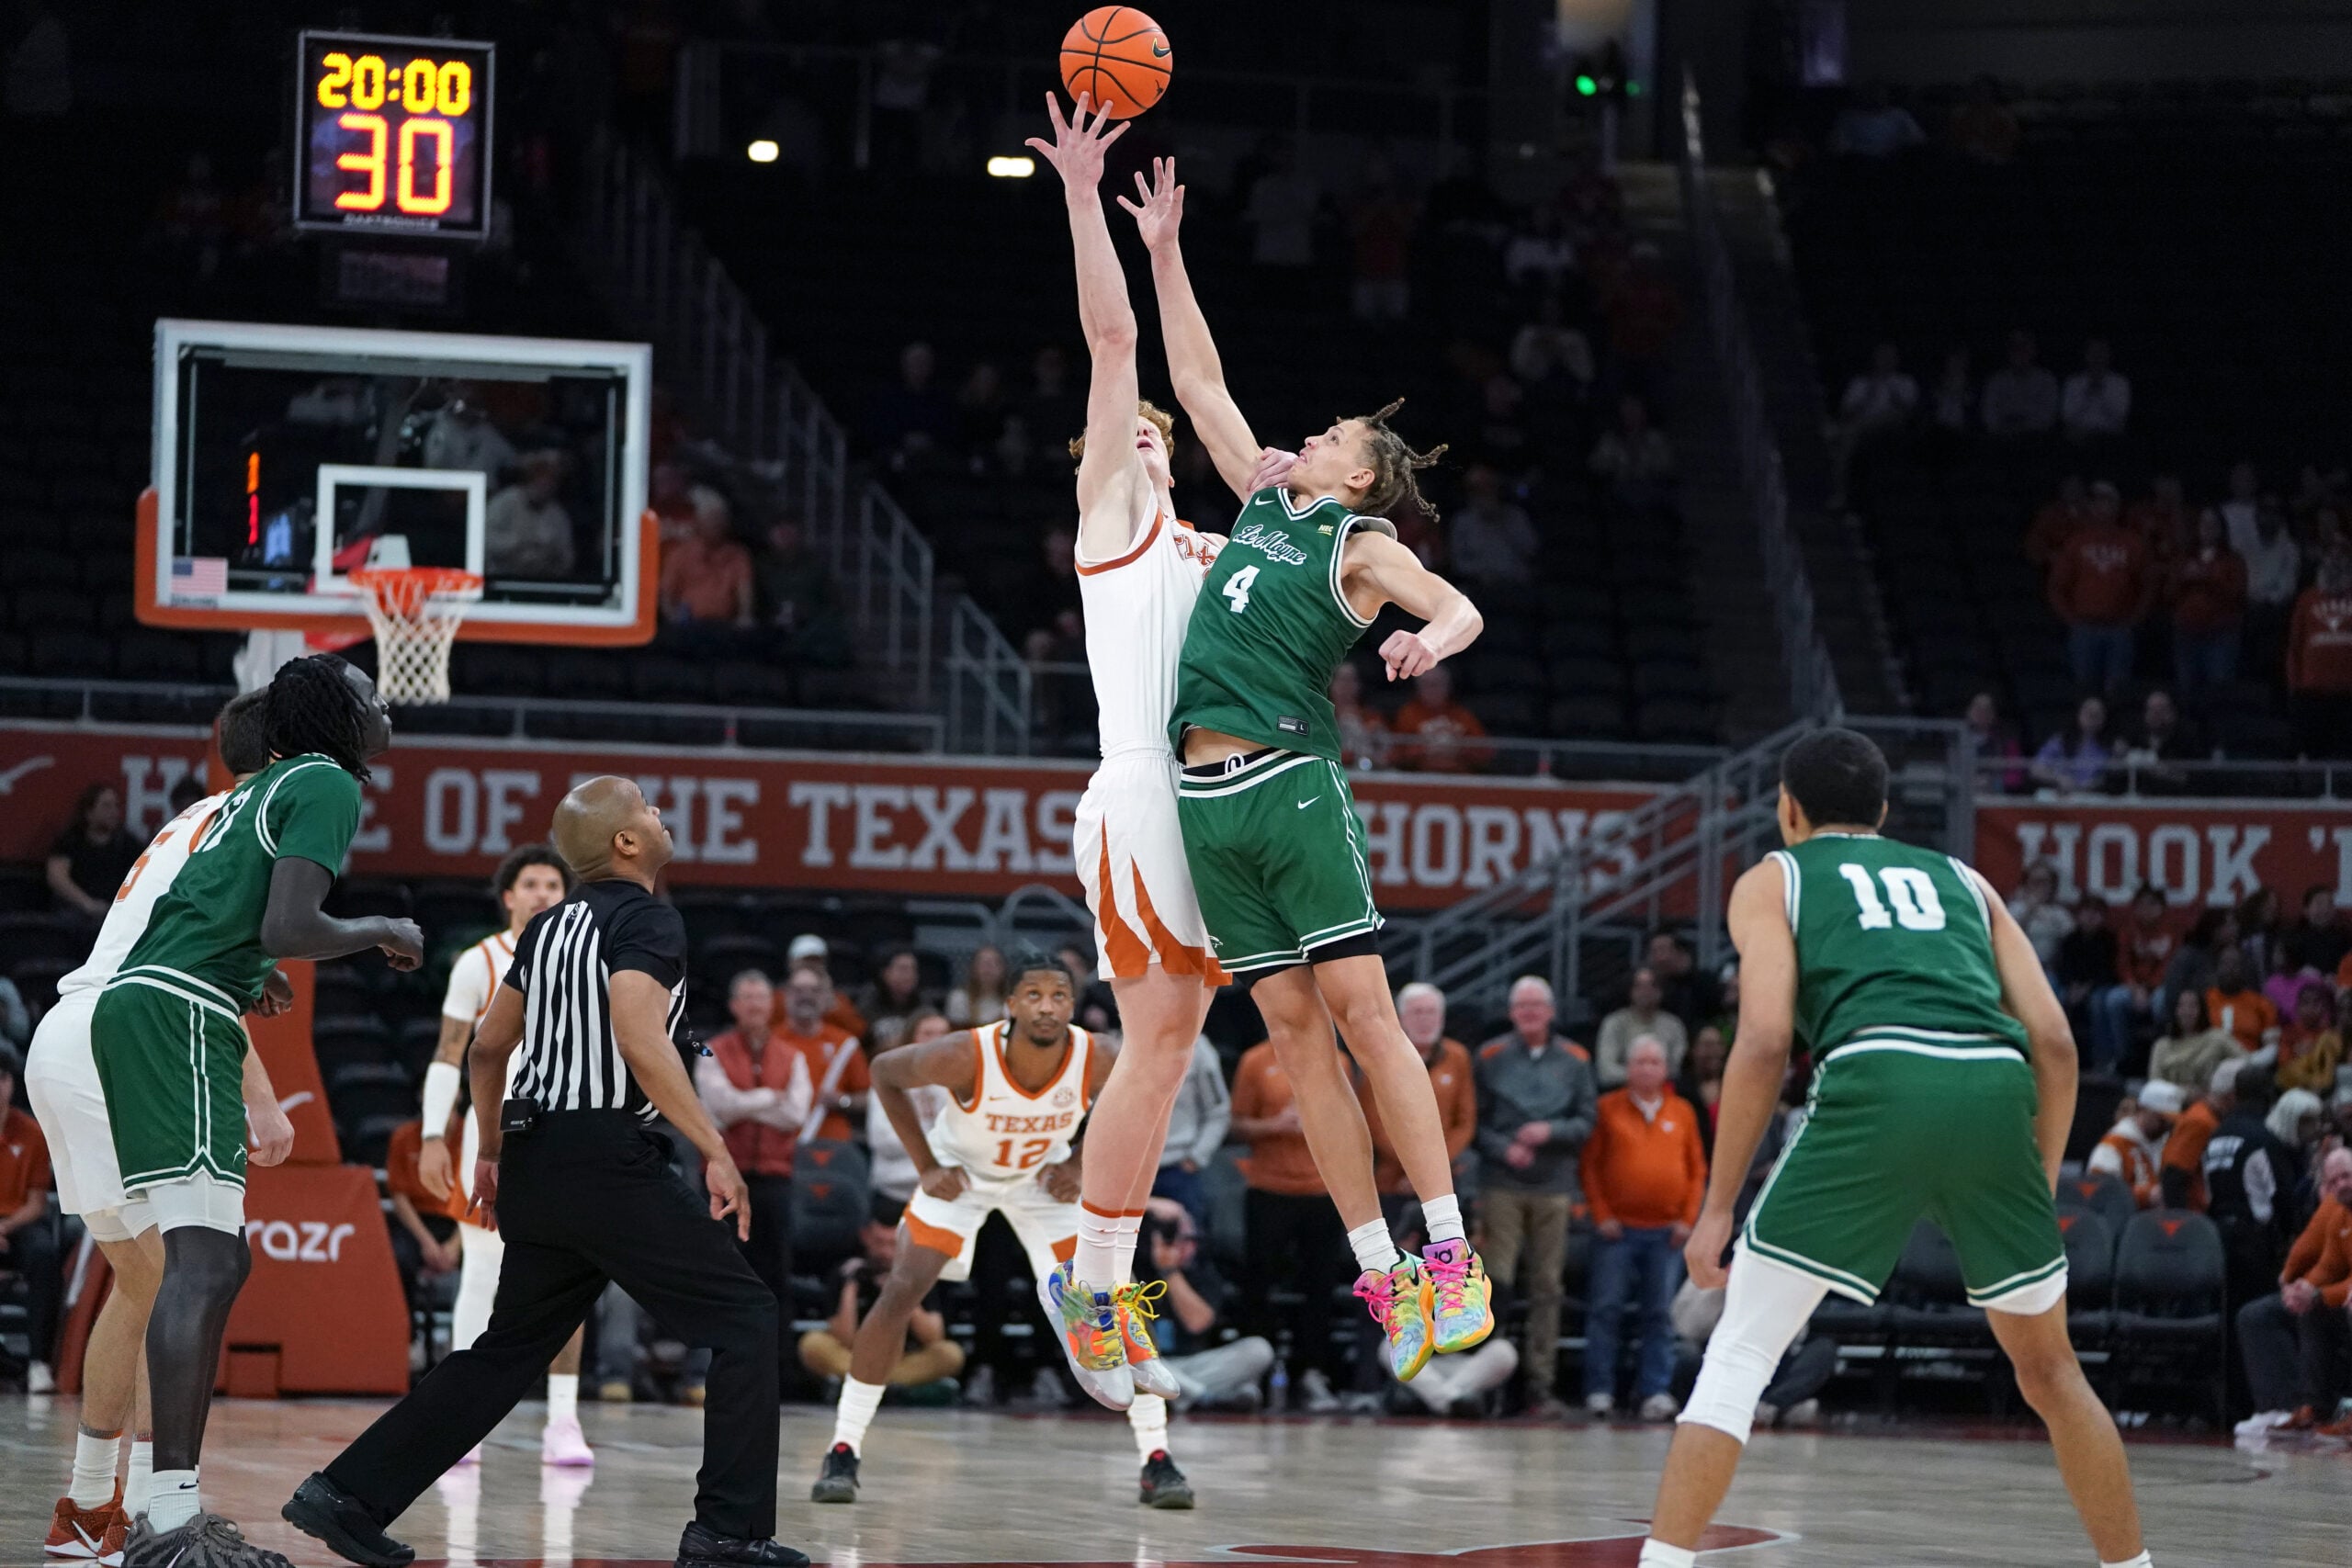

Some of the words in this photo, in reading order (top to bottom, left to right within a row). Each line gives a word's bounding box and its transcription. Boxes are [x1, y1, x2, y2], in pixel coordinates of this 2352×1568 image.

[317, 51, 472, 117] 20:00
[334, 111, 453, 216] 30
[1222, 564, 1261, 615] 4
[423, 767, 541, 855] OF
[786, 780, 1081, 874] TEXAS
[1353, 799, 1639, 893] HORNS
[1838, 863, 1947, 931] 10
[2015, 821, 2274, 909] HOOK
[985, 1111, 1075, 1134] TEXAS
[992, 1138, 1052, 1169] 12
[244, 1219, 356, 1264] razr
